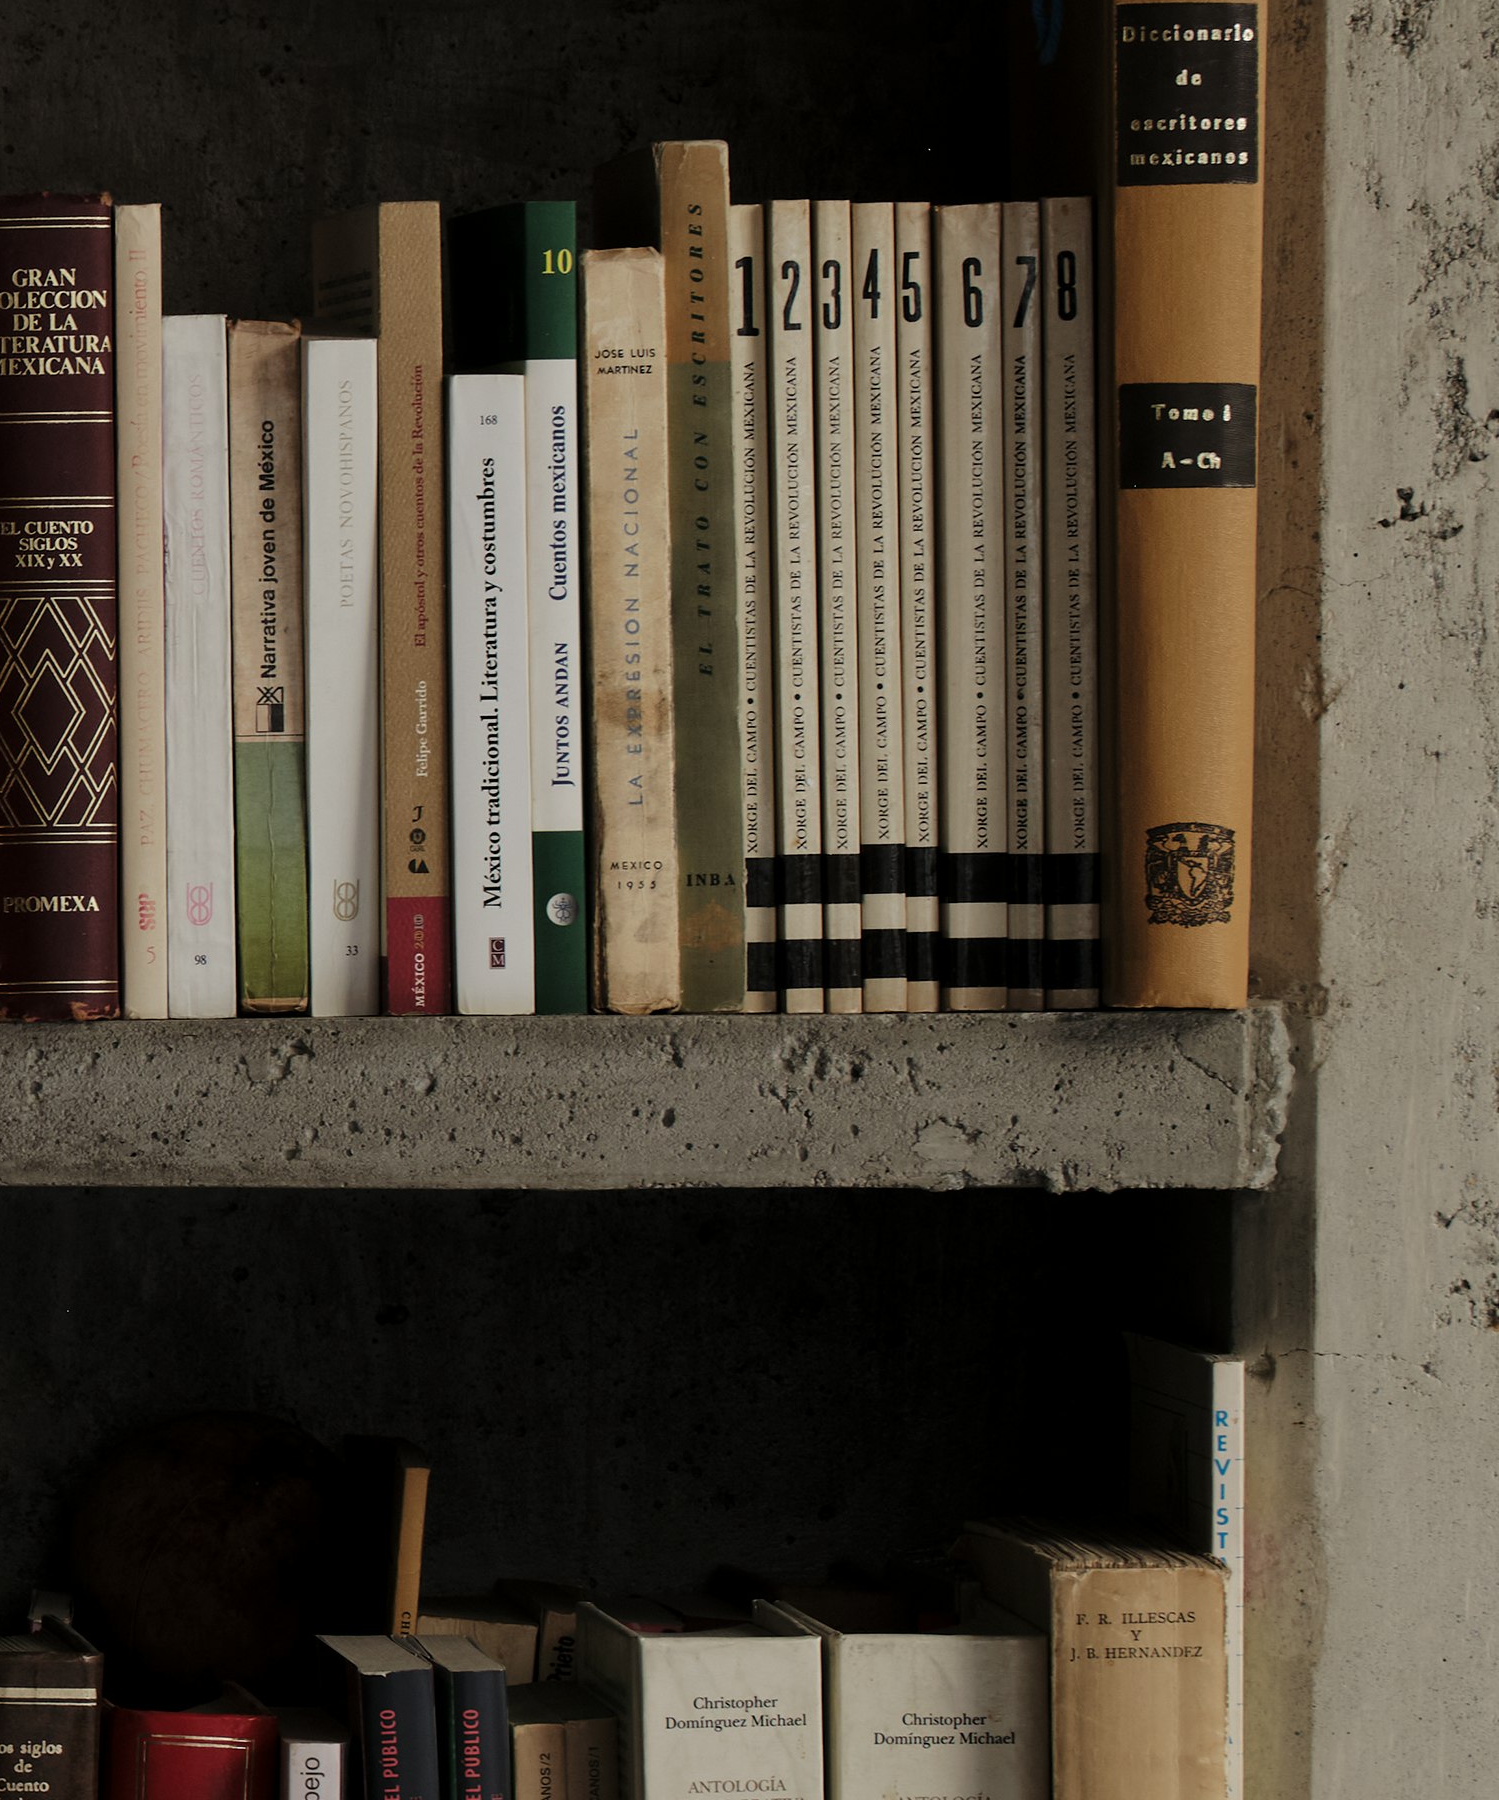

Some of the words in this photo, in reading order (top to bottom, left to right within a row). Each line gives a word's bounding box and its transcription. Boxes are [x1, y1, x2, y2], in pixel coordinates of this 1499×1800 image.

[1120, 26, 1254, 44] Diccionario
[1175, 71, 1202, 87] de
[1130, 115, 1247, 131] escritores
[1130, 149, 1249, 165] mexicanos
[542, 249, 572, 275] 10
[11, 267, 76, 287] GRAN
[863, 248, 880, 318] 4
[902, 251, 921, 322] 5
[1057, 251, 1077, 321] 8
[735, 256, 759, 336] 1
[781, 260, 801, 330] 2
[822, 259, 841, 329] 3
[963, 257, 982, 327] 6
[1013, 256, 1036, 327] 7
[13, 314, 44, 331] DE
[49, 314, 78, 331] LA
[1151, 404, 1214, 421] Tomo
[549, 405, 566, 513] mexicanos
[0, 520, 21, 535] EL
[24, 520, 94, 535] CUENTO
[19, 537, 79, 552] SIGLOS
[15, 553, 45, 568] XIX
[47, 556, 56, 571] y
[58, 552, 82, 567] XX
[549, 520, 568, 601] Cuentos
[3, 896, 99, 913] PROMEXA
[693, 1696, 778, 1711] Christopher
[665, 1714, 748, 1732] Domínguez
[751, 1713, 807, 1727] Michael
[20, 1739, 63, 1758] siglos
[13, 1759, 33, 1773] de
[688, 1777, 787, 1793] ANTOLOGÍA
